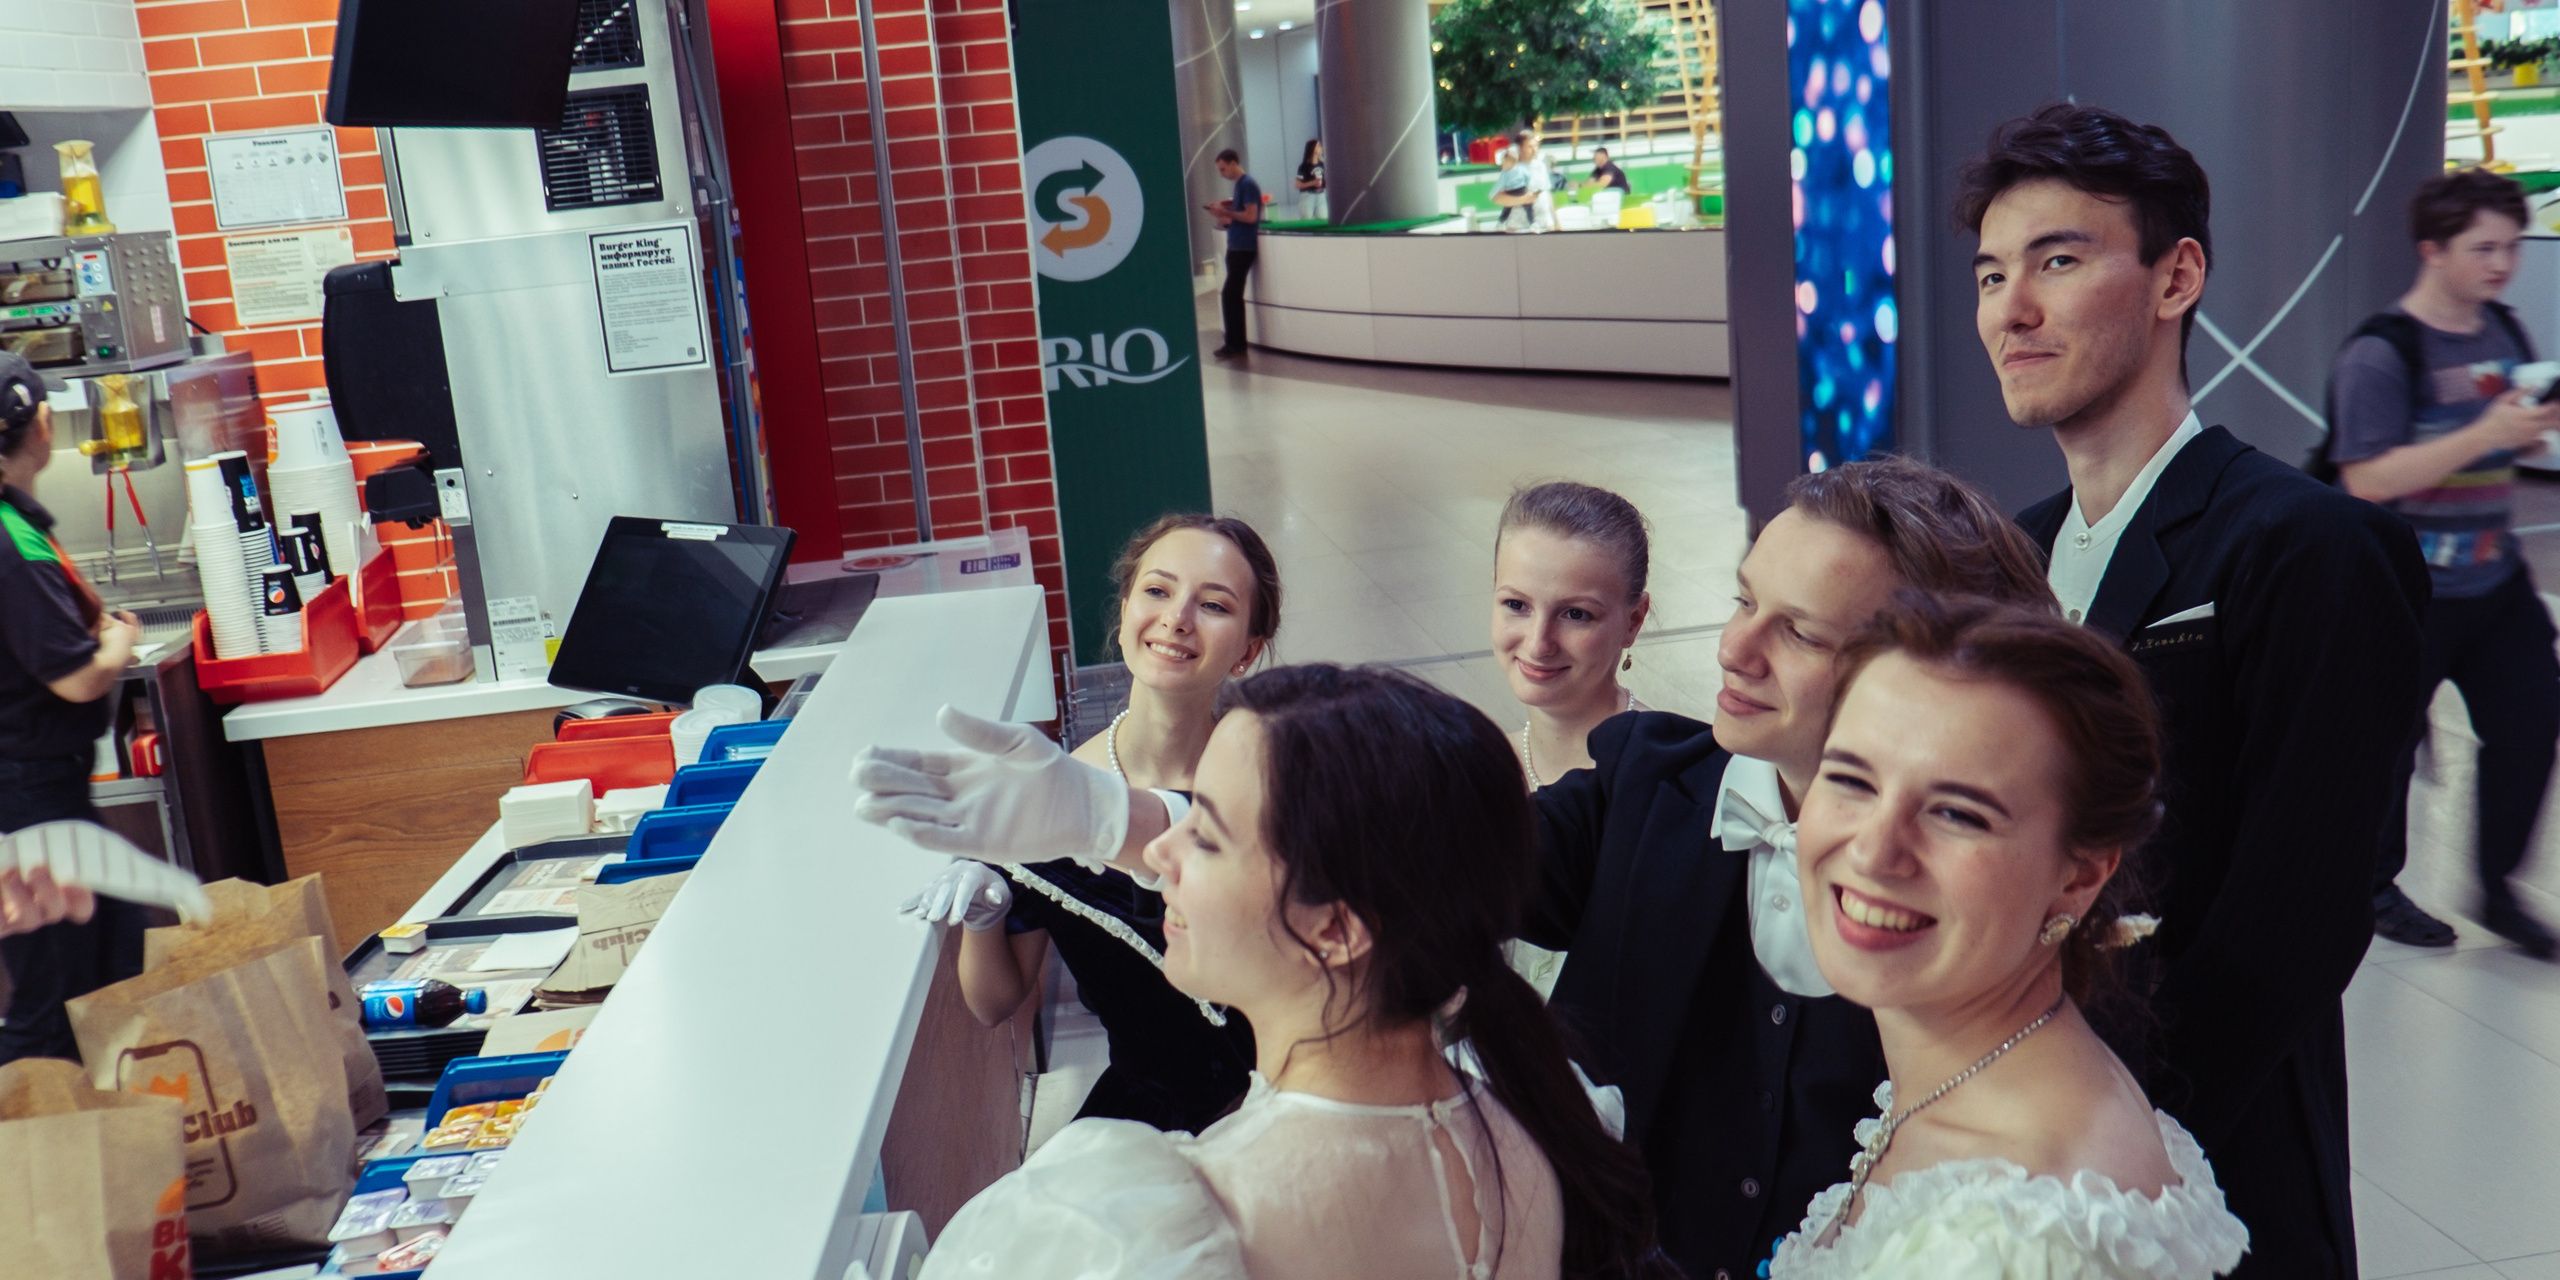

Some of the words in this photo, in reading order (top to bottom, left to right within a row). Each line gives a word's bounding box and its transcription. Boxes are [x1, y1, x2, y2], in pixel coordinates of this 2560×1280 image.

[599, 241, 634, 252] Burger
[636, 238, 660, 248] King
[600, 247, 672, 261] информирует
[602, 260, 635, 270] наших
[637, 255, 676, 267] Гостей:
[591, 928, 651, 951] Club
[183, 1100, 257, 1144] Club
